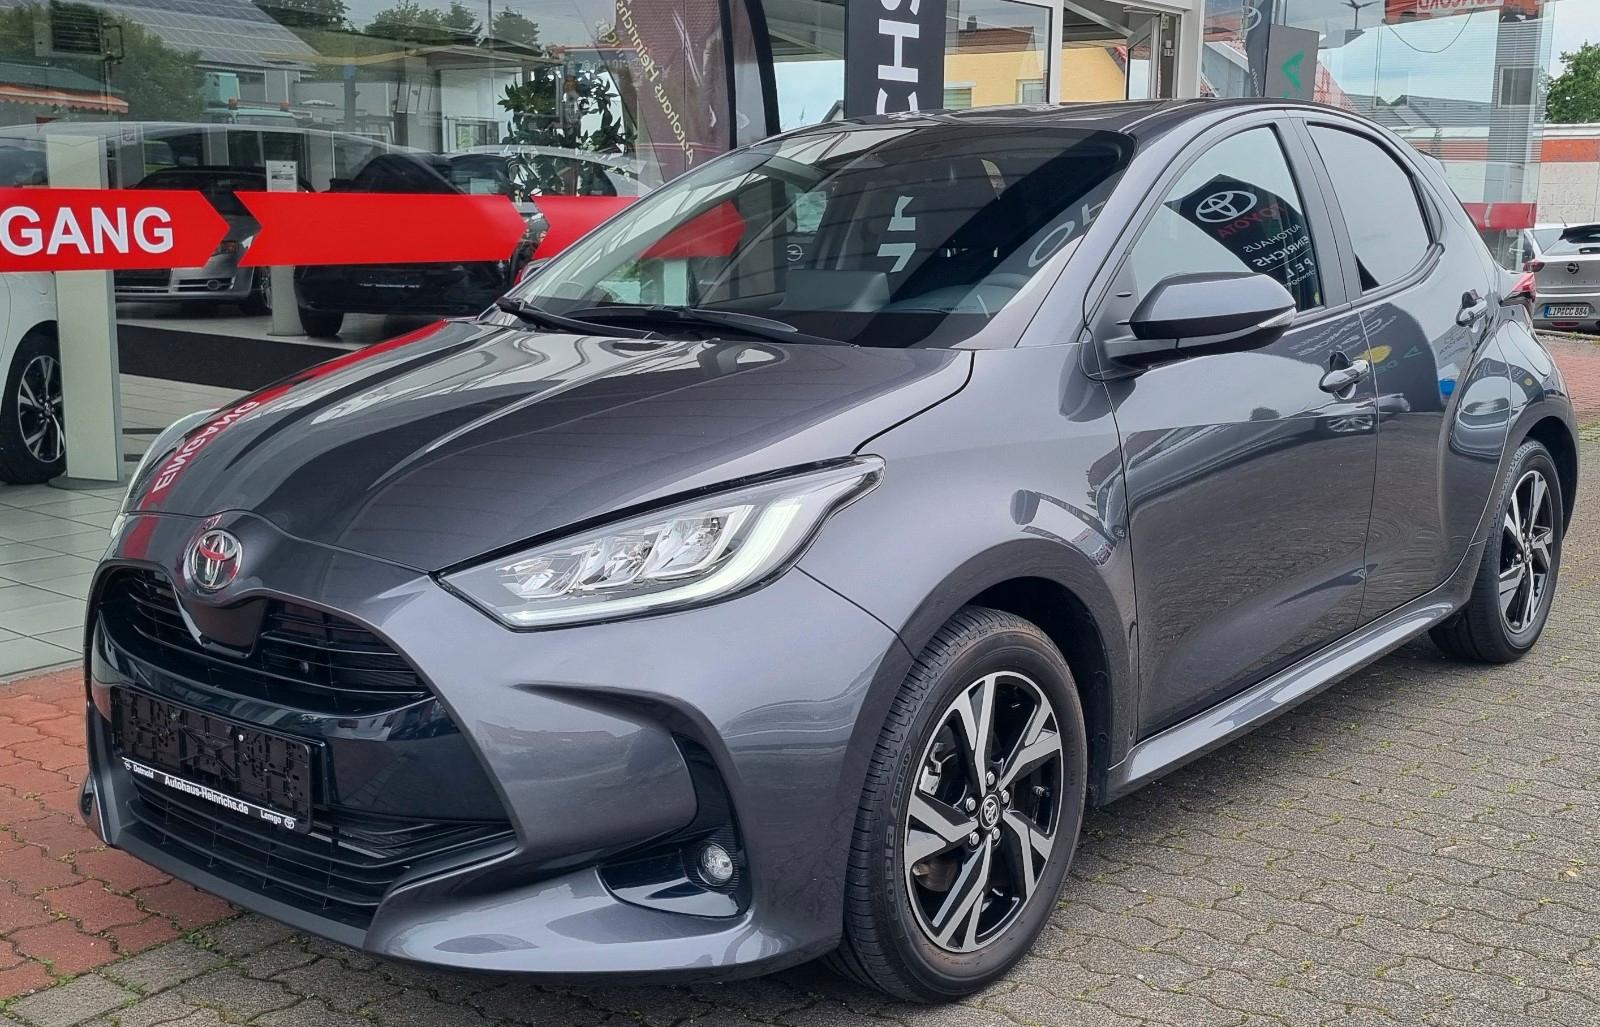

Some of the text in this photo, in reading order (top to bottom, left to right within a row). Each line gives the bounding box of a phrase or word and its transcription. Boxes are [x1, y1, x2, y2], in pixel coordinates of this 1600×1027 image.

[0, 206, 174, 256] GANG
[1549, 306, 1562, 316] LIP
[165, 775, 249, 815] Autohaus-Heinrichs.de
[260, 809, 282, 825] Lemgo
